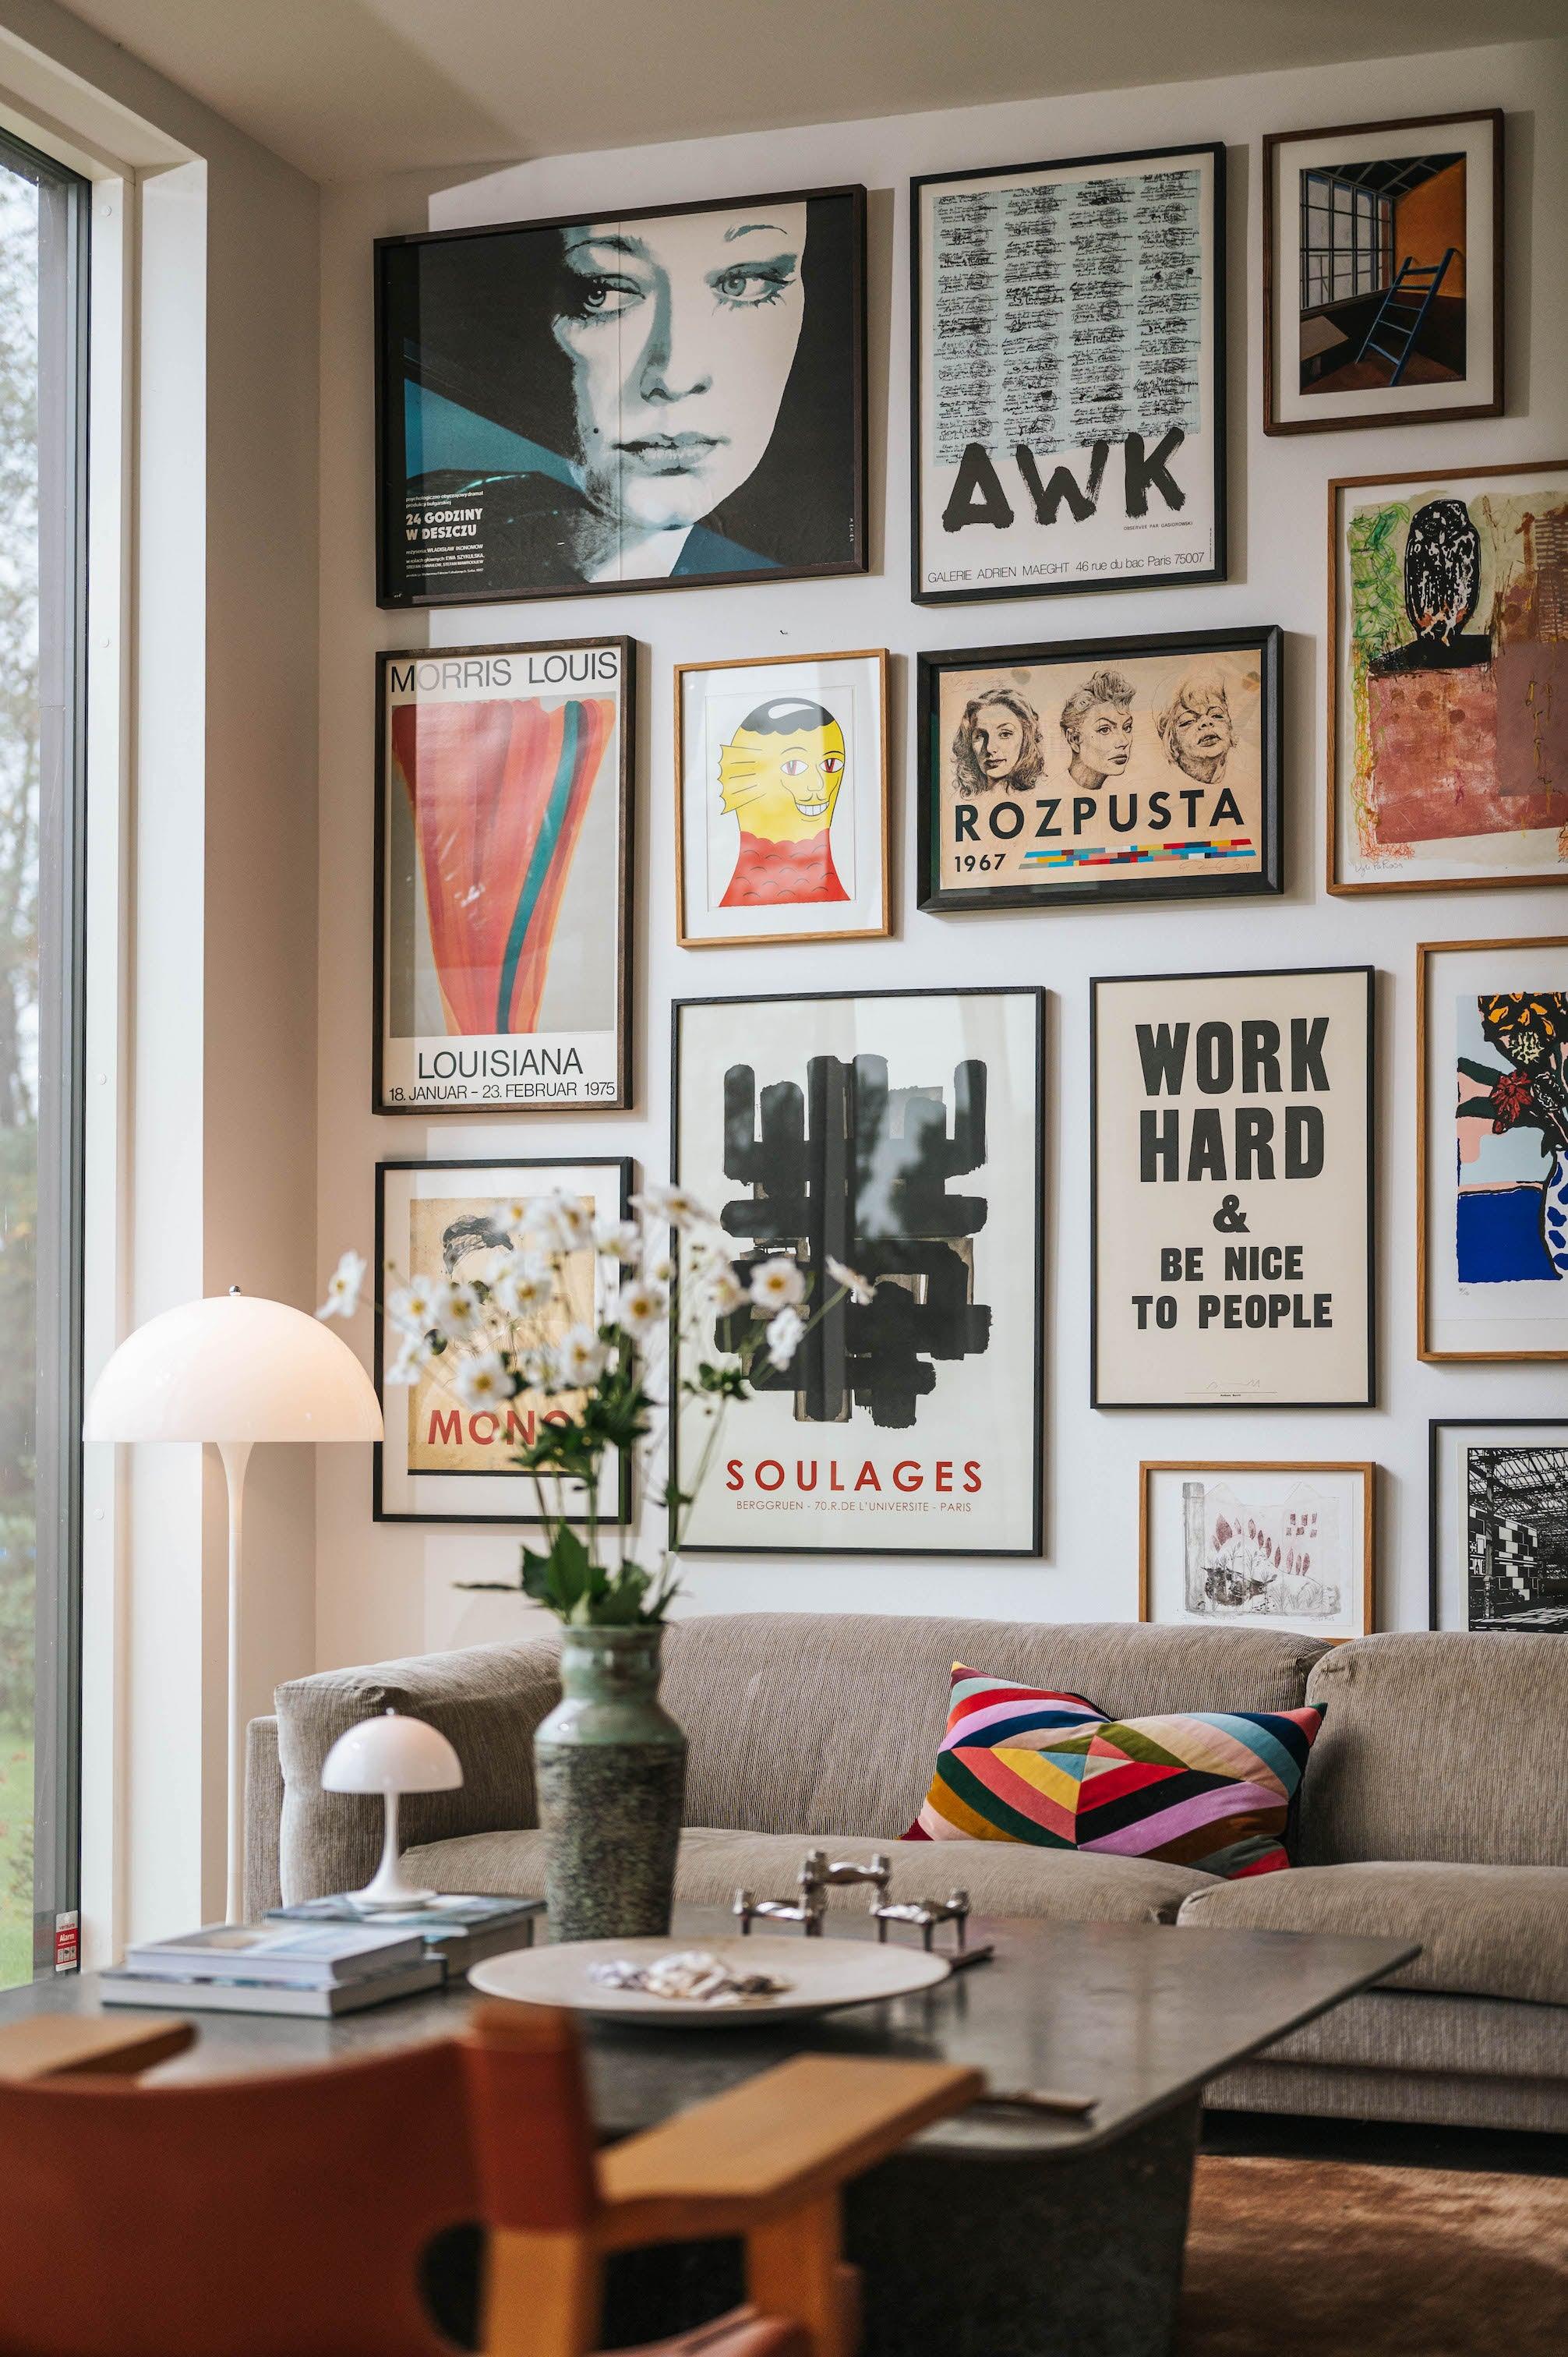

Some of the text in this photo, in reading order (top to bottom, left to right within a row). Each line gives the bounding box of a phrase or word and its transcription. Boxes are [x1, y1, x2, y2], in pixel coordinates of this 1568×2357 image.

[941, 426, 1186, 533] AWK
[406, 508, 483, 525] 24 GODZINY
[406, 524, 477, 541] W DESZCZU
[927, 552, 1205, 583] GALERIE ADRIEN MAEGHT 46 rue du bac Paris 75007
[391, 652, 617, 693] MORRIS LOUIS
[955, 787, 1245, 843] ROZPUSTA
[955, 853, 1007, 873] 1967
[418, 1048, 584, 1080] LOUISIANA
[1135, 1017, 1330, 1096] WORK
[390, 1087, 406, 1101] 18.
[408, 1085, 468, 1101] JANUAR
[482, 1084, 502, 1099] 23.
[507, 1082, 577, 1097] FEBRUAR
[584, 1082, 616, 1096] 1975
[1139, 1105, 1325, 1182] HARD
[1213, 1194, 1251, 1233] &
[1160, 1246, 1303, 1281] BE NICE
[1132, 1294, 1333, 1330] TO PEOPLE
[725, 1459, 982, 1493] SOULAGES
[736, 1500, 803, 1511] BERGGRUEN
[859, 1501, 929, 1512] L'UNIVERSITE
[940, 1503, 972, 1512] PARIS
[59, 1933, 75, 1942] Alarm
